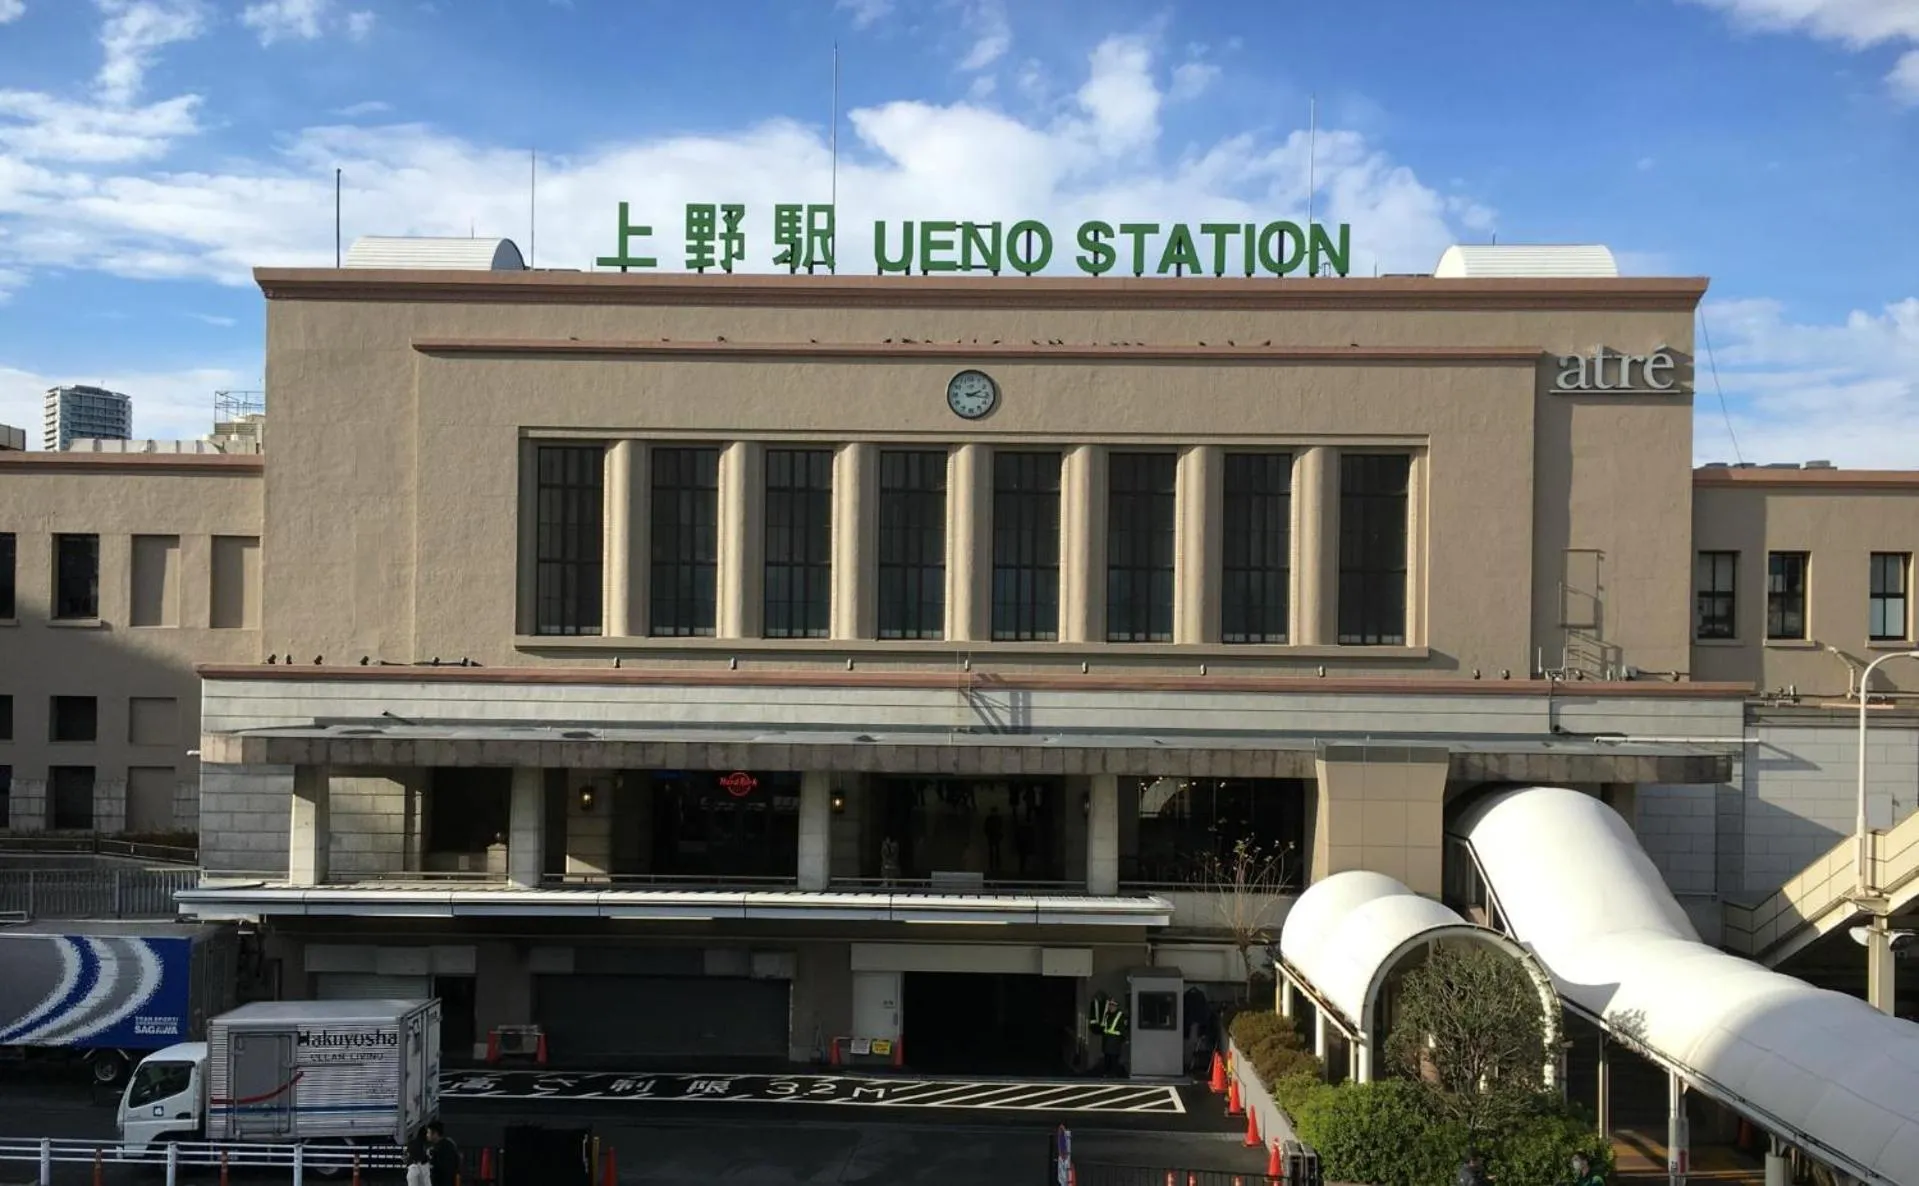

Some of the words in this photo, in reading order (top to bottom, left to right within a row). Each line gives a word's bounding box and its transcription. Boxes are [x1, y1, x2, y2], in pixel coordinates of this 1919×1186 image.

[597, 201, 836, 270] 上野駅
[874, 220, 1053, 273] UENO
[1076, 220, 1351, 273] STATION
[1556, 343, 1676, 390] atré
[135, 1025, 178, 1035] SAGAWA
[297, 1028, 398, 1049] Hakuyosha
